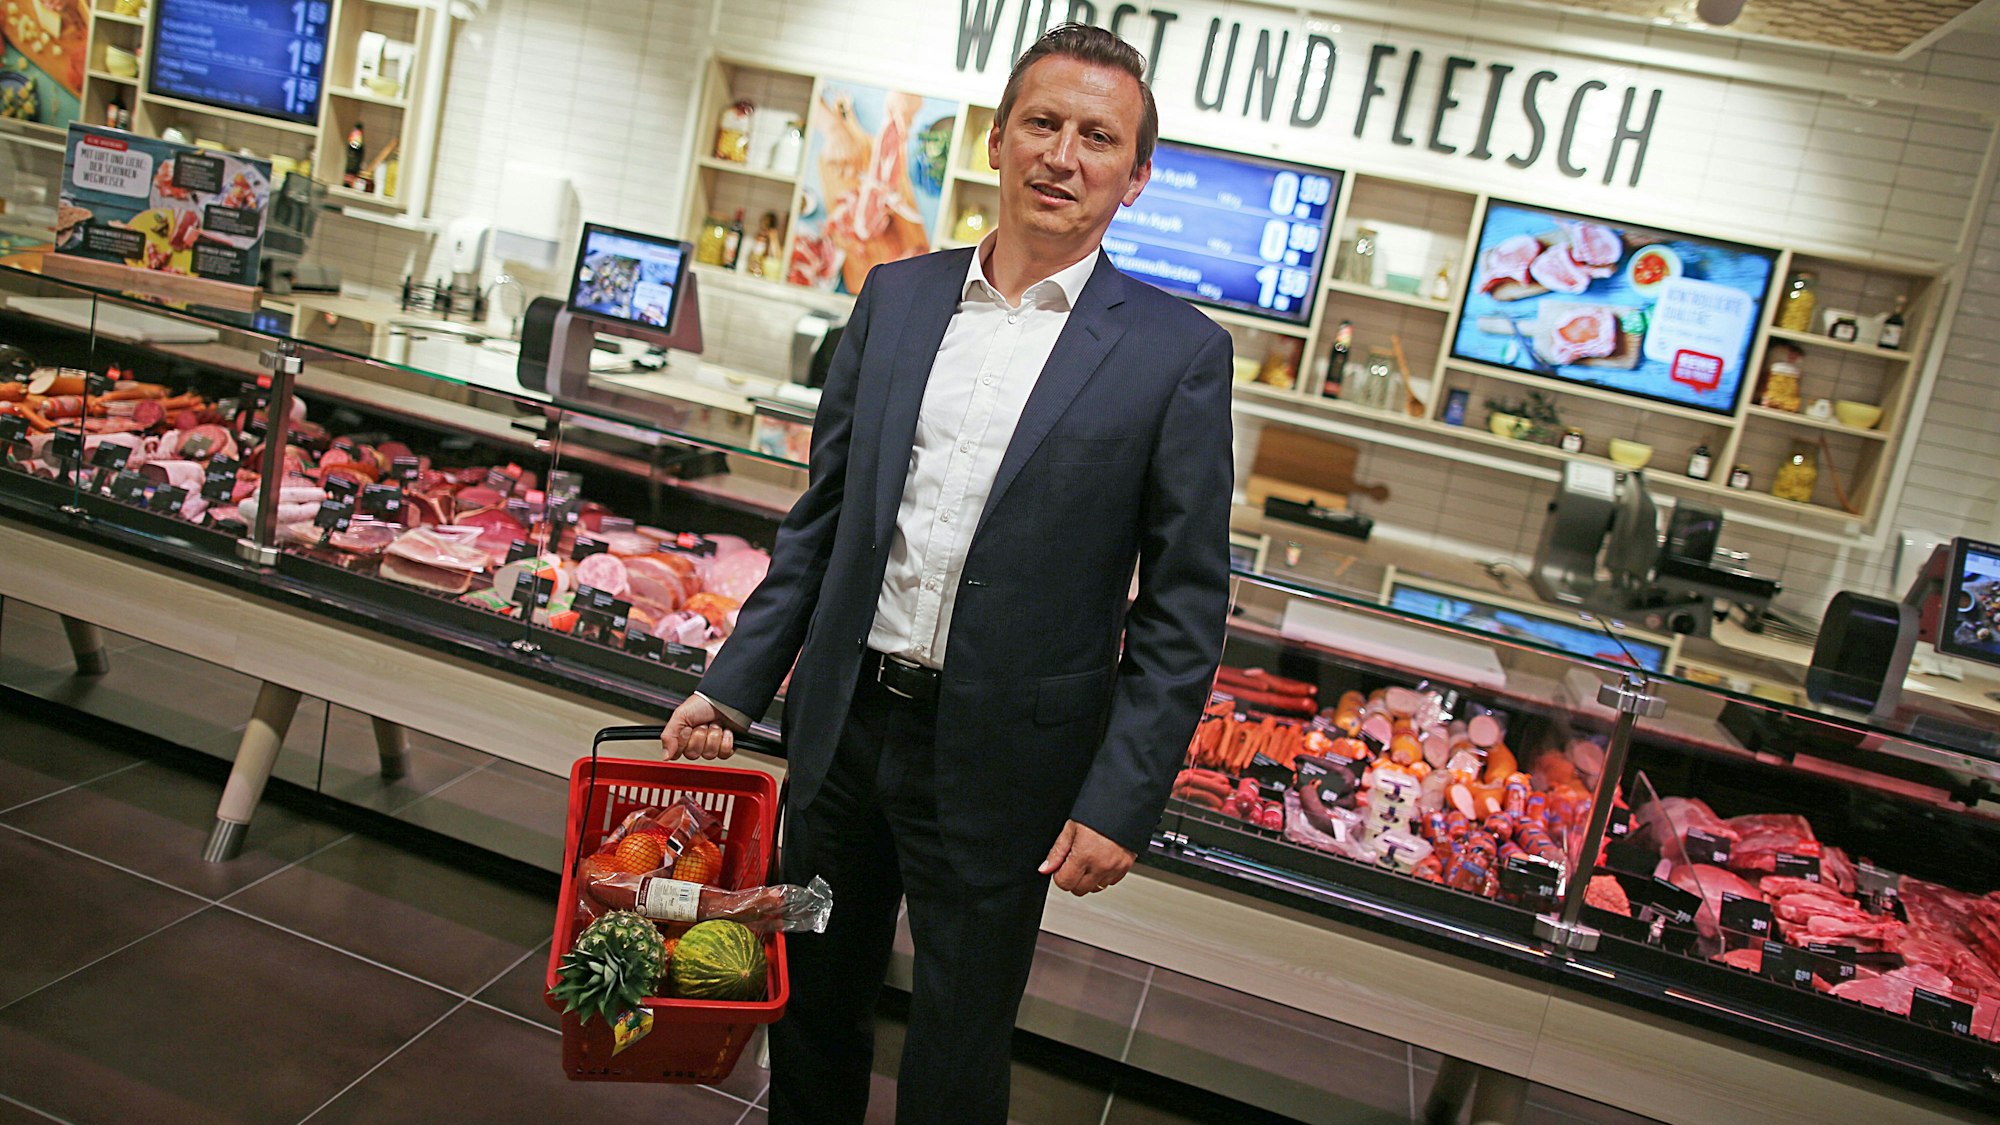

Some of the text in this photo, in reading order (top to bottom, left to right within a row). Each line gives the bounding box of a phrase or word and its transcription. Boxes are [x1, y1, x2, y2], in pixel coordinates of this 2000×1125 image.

[1195, 17, 1336, 128] UND
[1353, 44, 1663, 188] FLEISCH
[89, 161, 102, 173] DER
